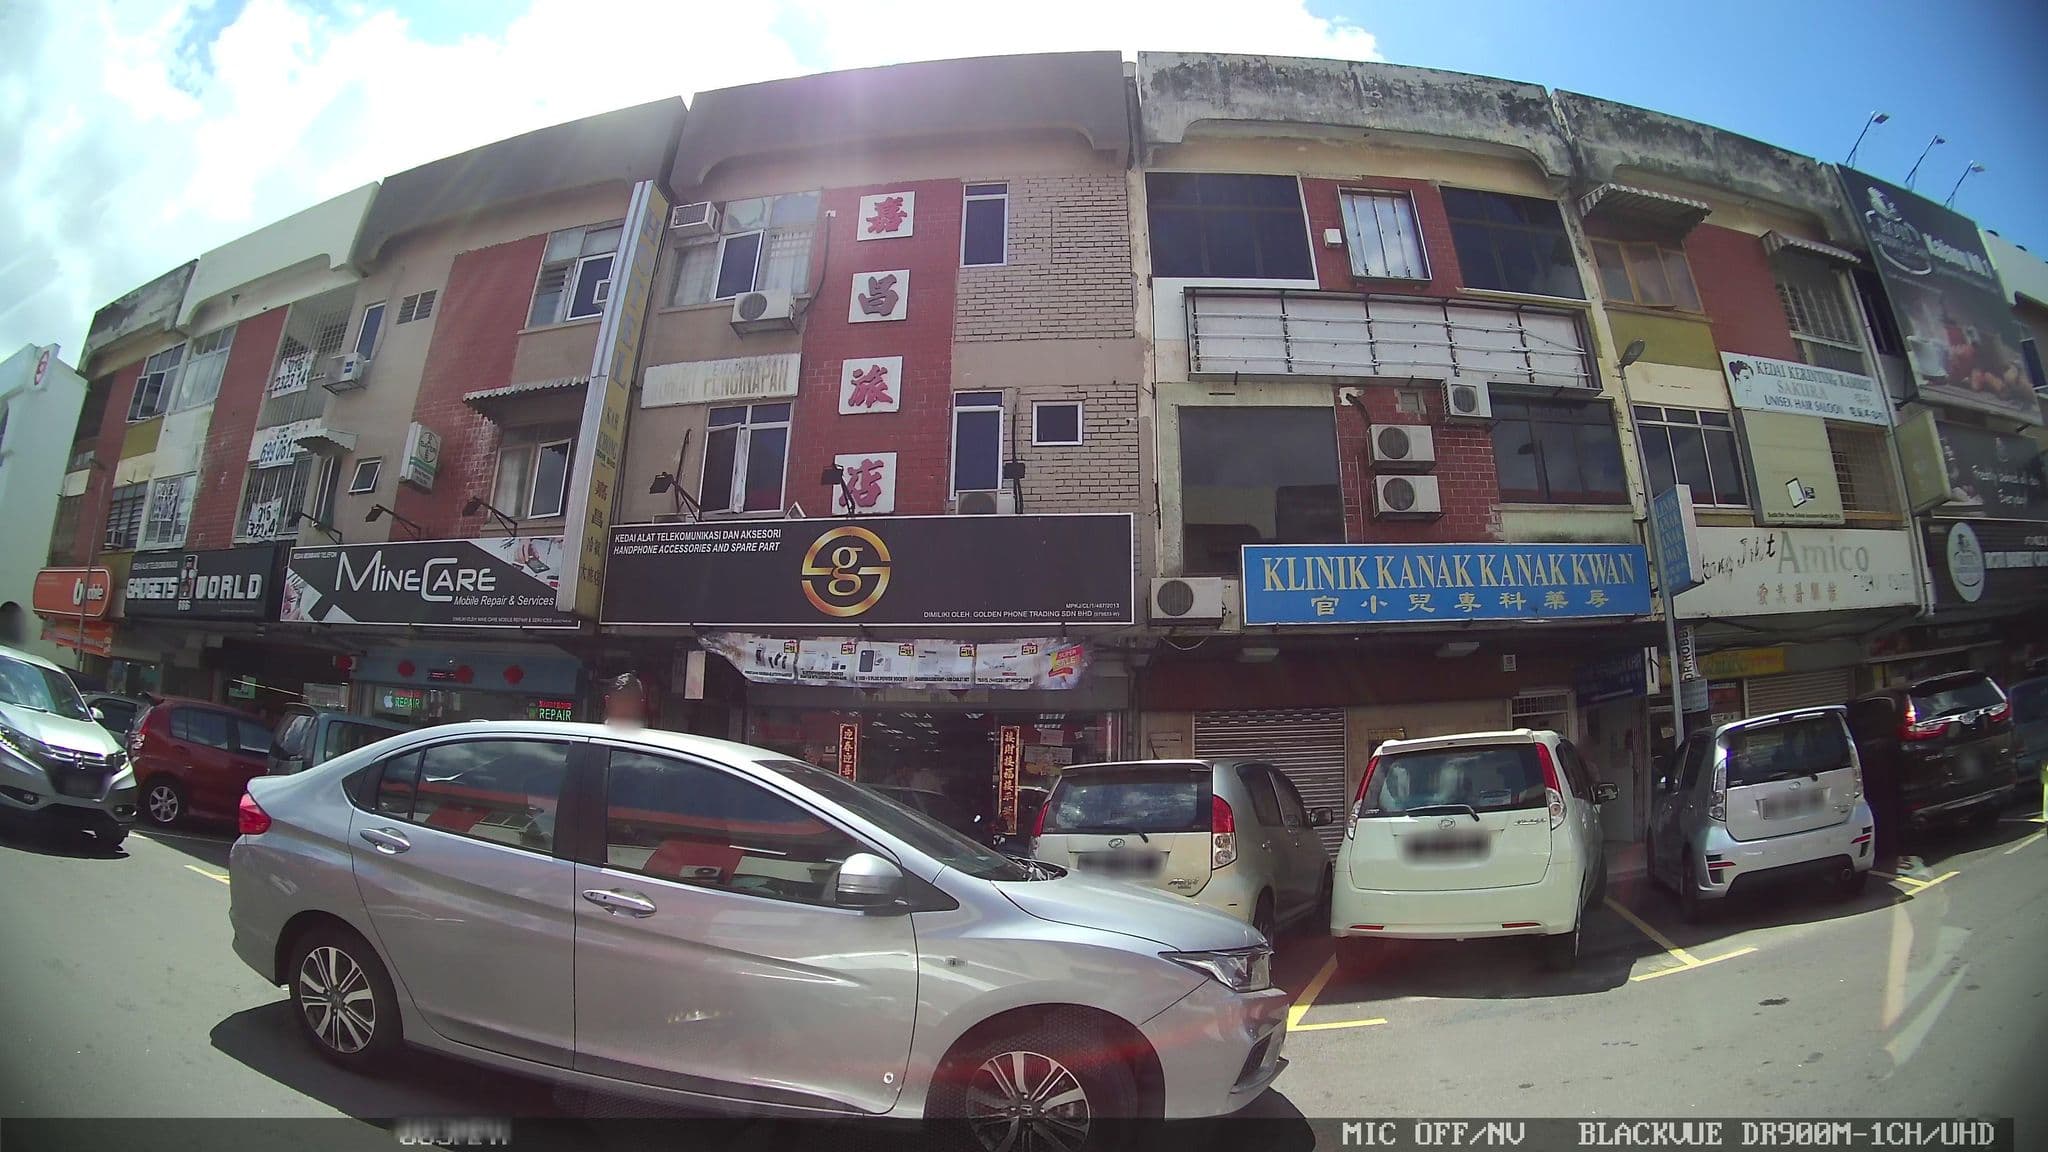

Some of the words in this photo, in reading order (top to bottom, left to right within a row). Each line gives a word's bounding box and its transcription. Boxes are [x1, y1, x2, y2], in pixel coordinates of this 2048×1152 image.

[615, 533, 637, 543] KEDAI
[637, 533, 656, 542] ALAT
[656, 531, 722, 542] TELEKOMUNIKASI
[722, 530, 739, 540] DAN
[740, 529, 782, 540] AKSESORI
[613, 545, 658, 555] HANDPHONE
[658, 543, 712, 554] ACCESSORIES
[712, 543, 729, 553] AND
[730, 542, 757, 552] SPARE
[758, 541, 781, 551] PART
[1262, 556, 1371, 591] KLINIK
[1376, 554, 1475, 589] KANAK
[1477, 554, 1569, 588] KANAK
[1571, 553, 1635, 586] KWAN
[195, 574, 262, 599] WORLD
[454, 595, 478, 606] Mobile
[480, 595, 507, 607] Repair
[508, 595, 515, 606] &
[517, 595, 555, 606] Services
[973, 610, 1002, 618] GOLDEN
[1003, 610, 1028, 618] PHONE
[540, 708, 572, 721] REPAIR
